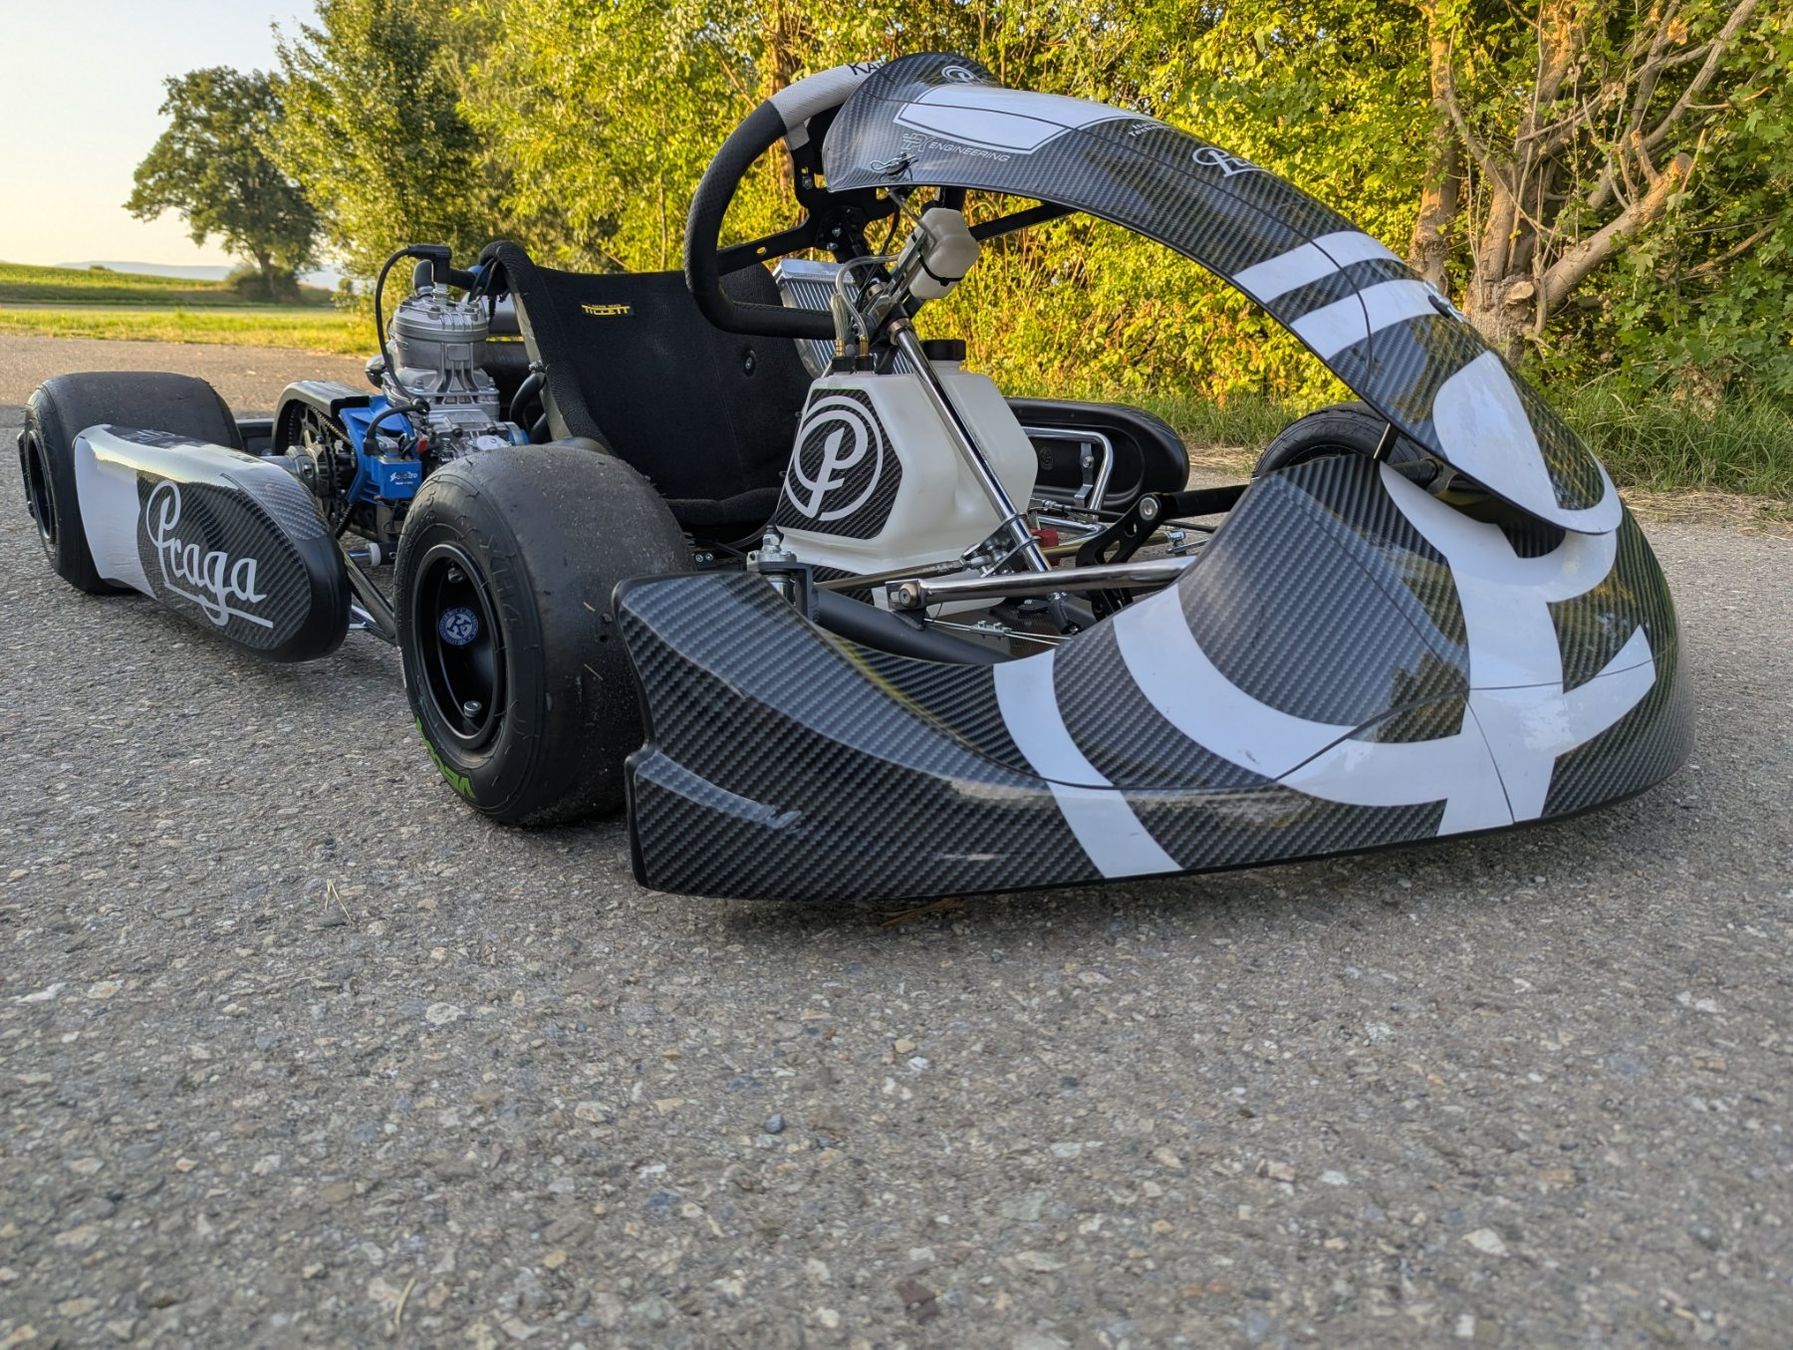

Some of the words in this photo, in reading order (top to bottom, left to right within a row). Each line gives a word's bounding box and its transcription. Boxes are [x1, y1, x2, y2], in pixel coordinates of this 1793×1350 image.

[928, 141, 1011, 162] ENGINEERING
[581, 304, 630, 316] TILLETT
[146, 480, 274, 628] Praga
